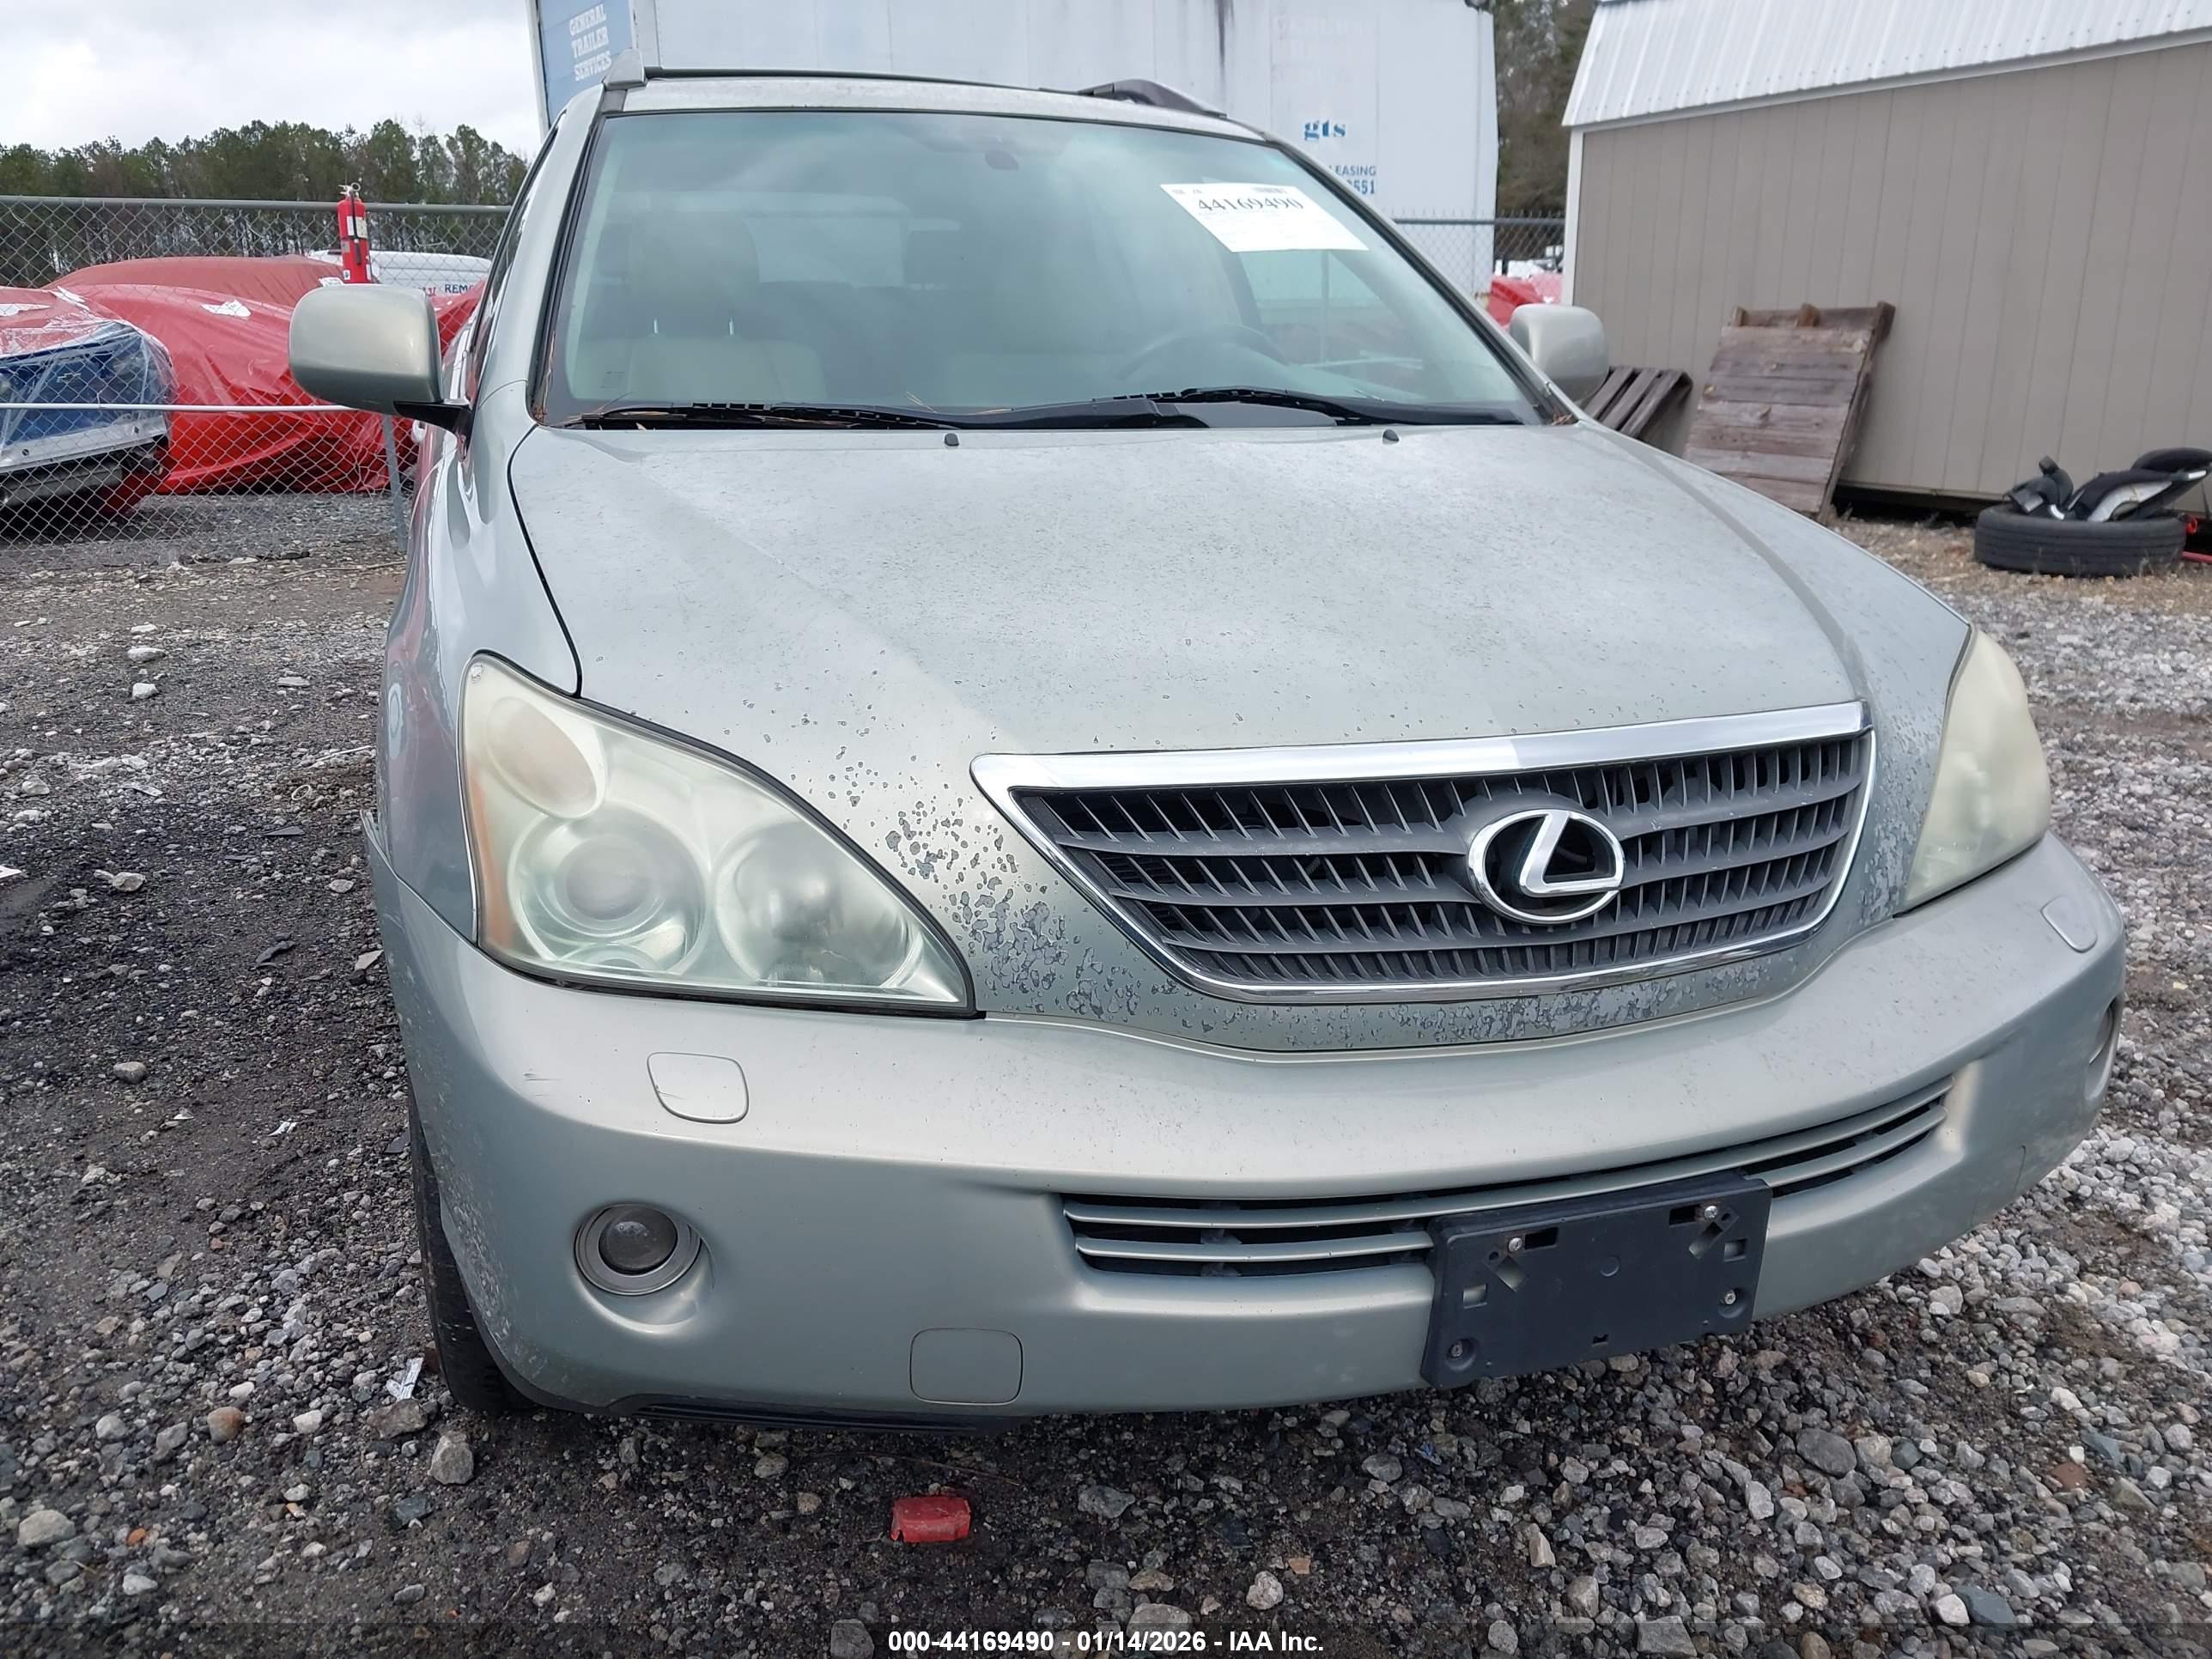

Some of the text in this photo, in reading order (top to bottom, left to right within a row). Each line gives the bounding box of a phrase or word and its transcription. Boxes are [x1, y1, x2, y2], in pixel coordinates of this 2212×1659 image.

[569, 3, 607, 36] GENERAL
[571, 26, 610, 58] TRAILER
[574, 50, 612, 82] SERVICES
[1304, 119, 1346, 141] gts
[1198, 197, 1304, 211] 44169490
